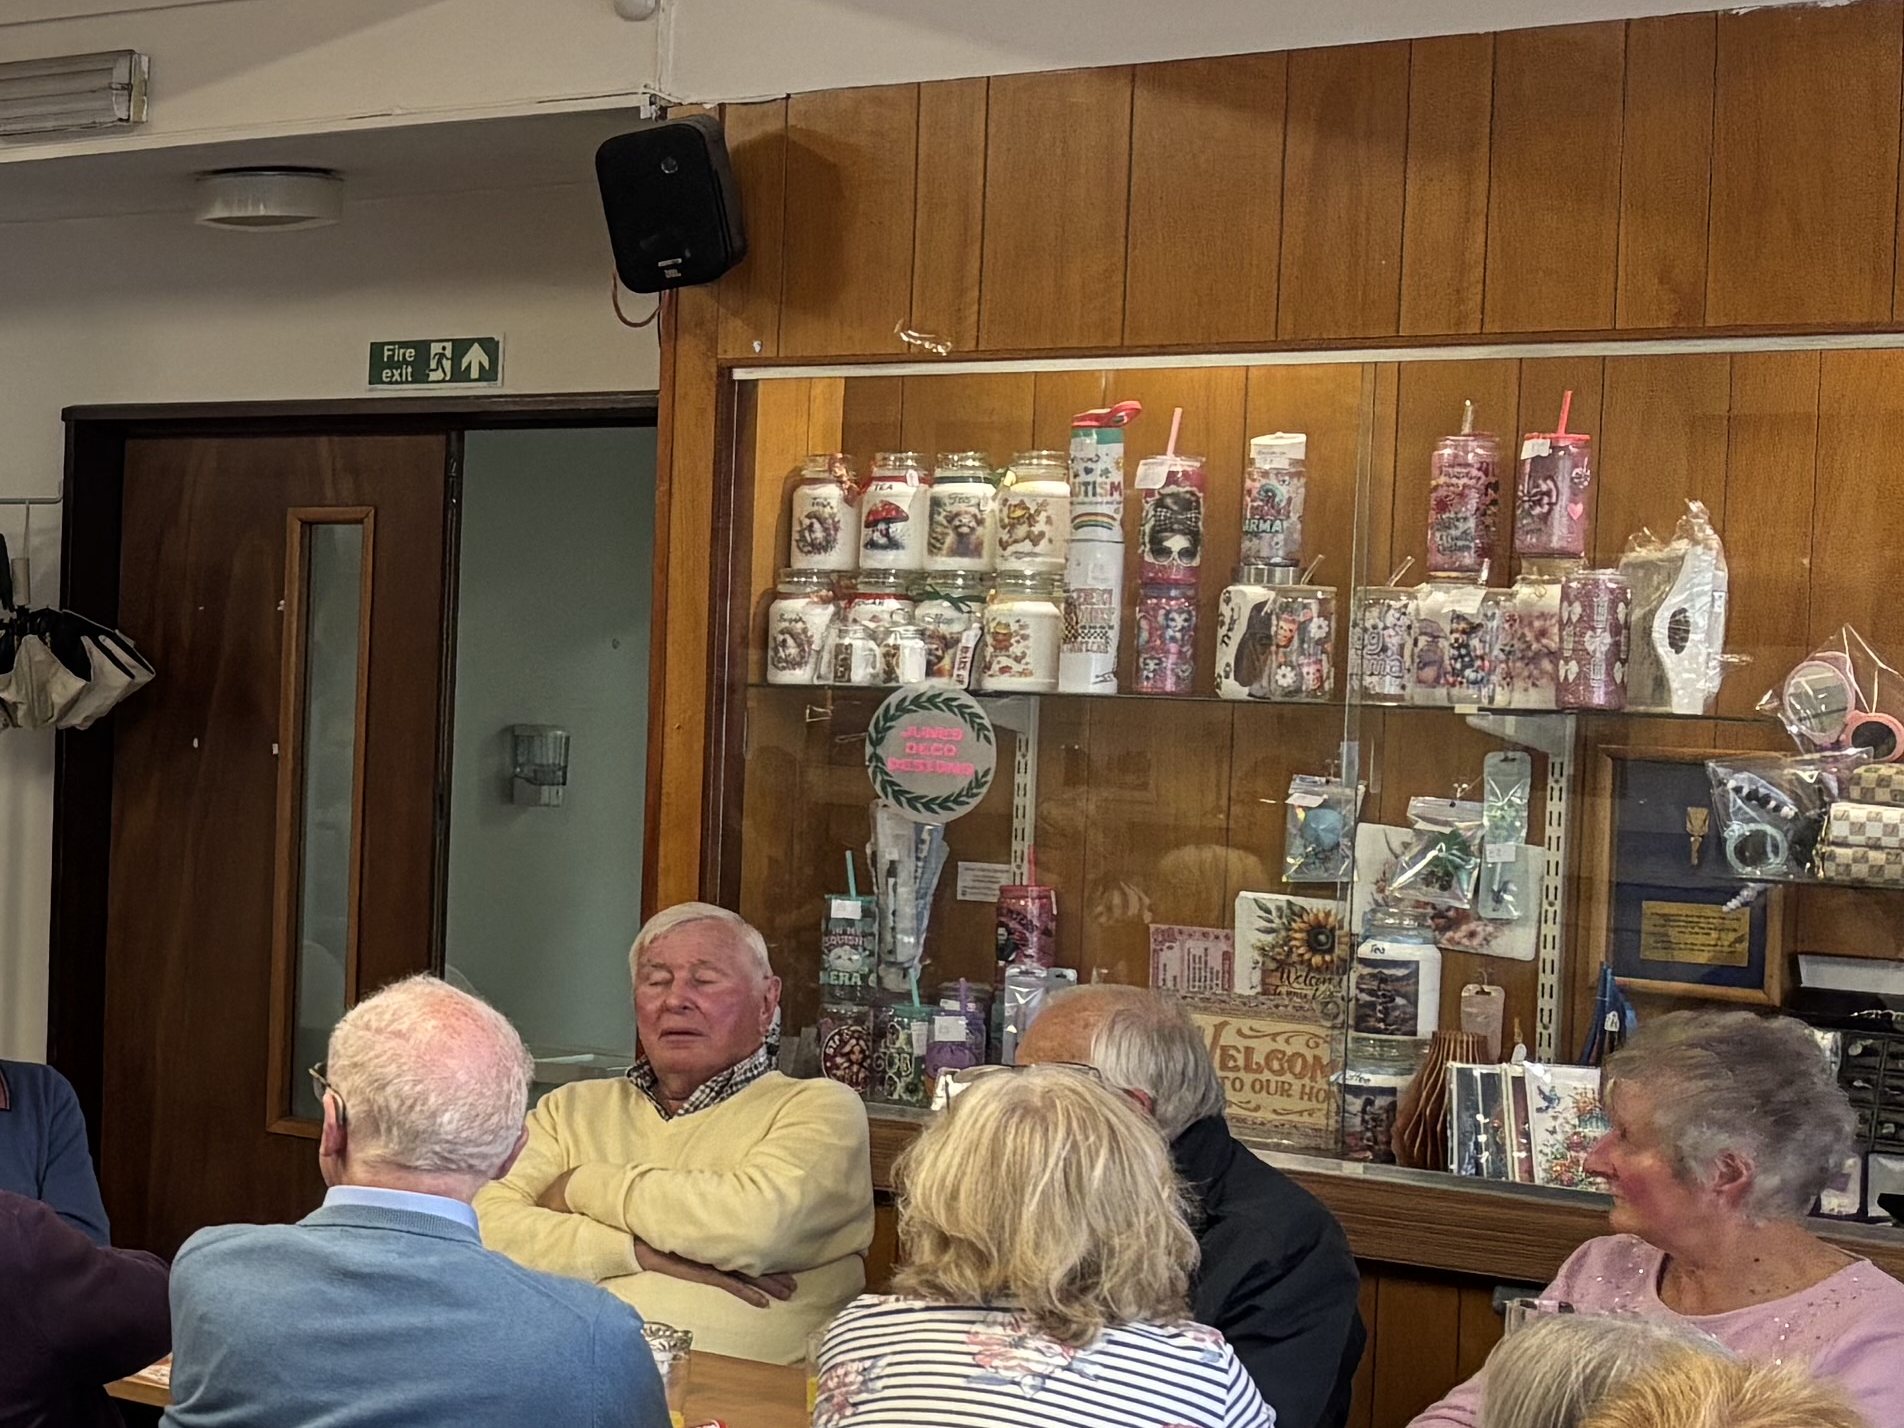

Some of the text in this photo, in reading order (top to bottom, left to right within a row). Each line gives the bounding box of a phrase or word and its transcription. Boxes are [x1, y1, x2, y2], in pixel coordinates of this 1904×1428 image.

[383, 345, 416, 362] Fire
[382, 365, 412, 382] exit
[1071, 480, 1123, 498] UTISM
[1249, 1076, 1293, 1099] OUR
